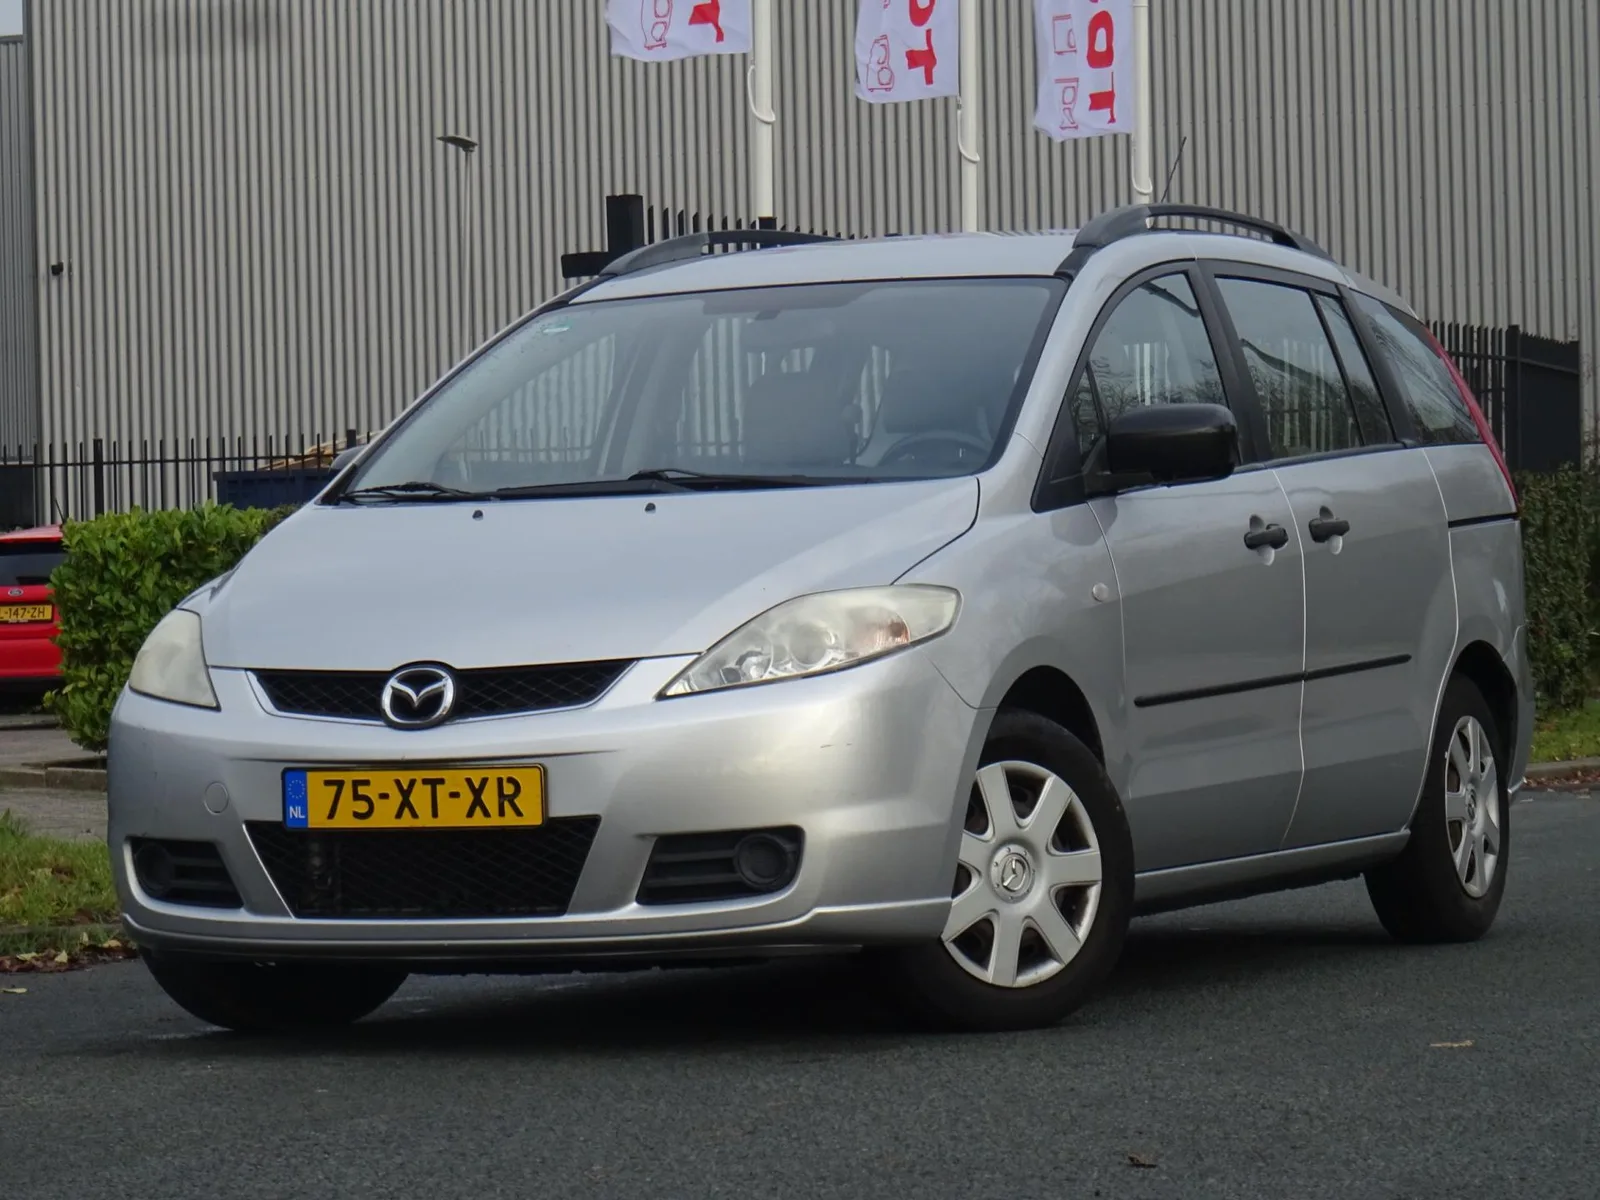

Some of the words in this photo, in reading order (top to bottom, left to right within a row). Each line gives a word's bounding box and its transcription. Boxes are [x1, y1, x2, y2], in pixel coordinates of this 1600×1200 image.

[0, 607, 46, 619] -147-ZH
[323, 776, 524, 820] 75-XT-XR
[289, 806, 306, 819] NL
